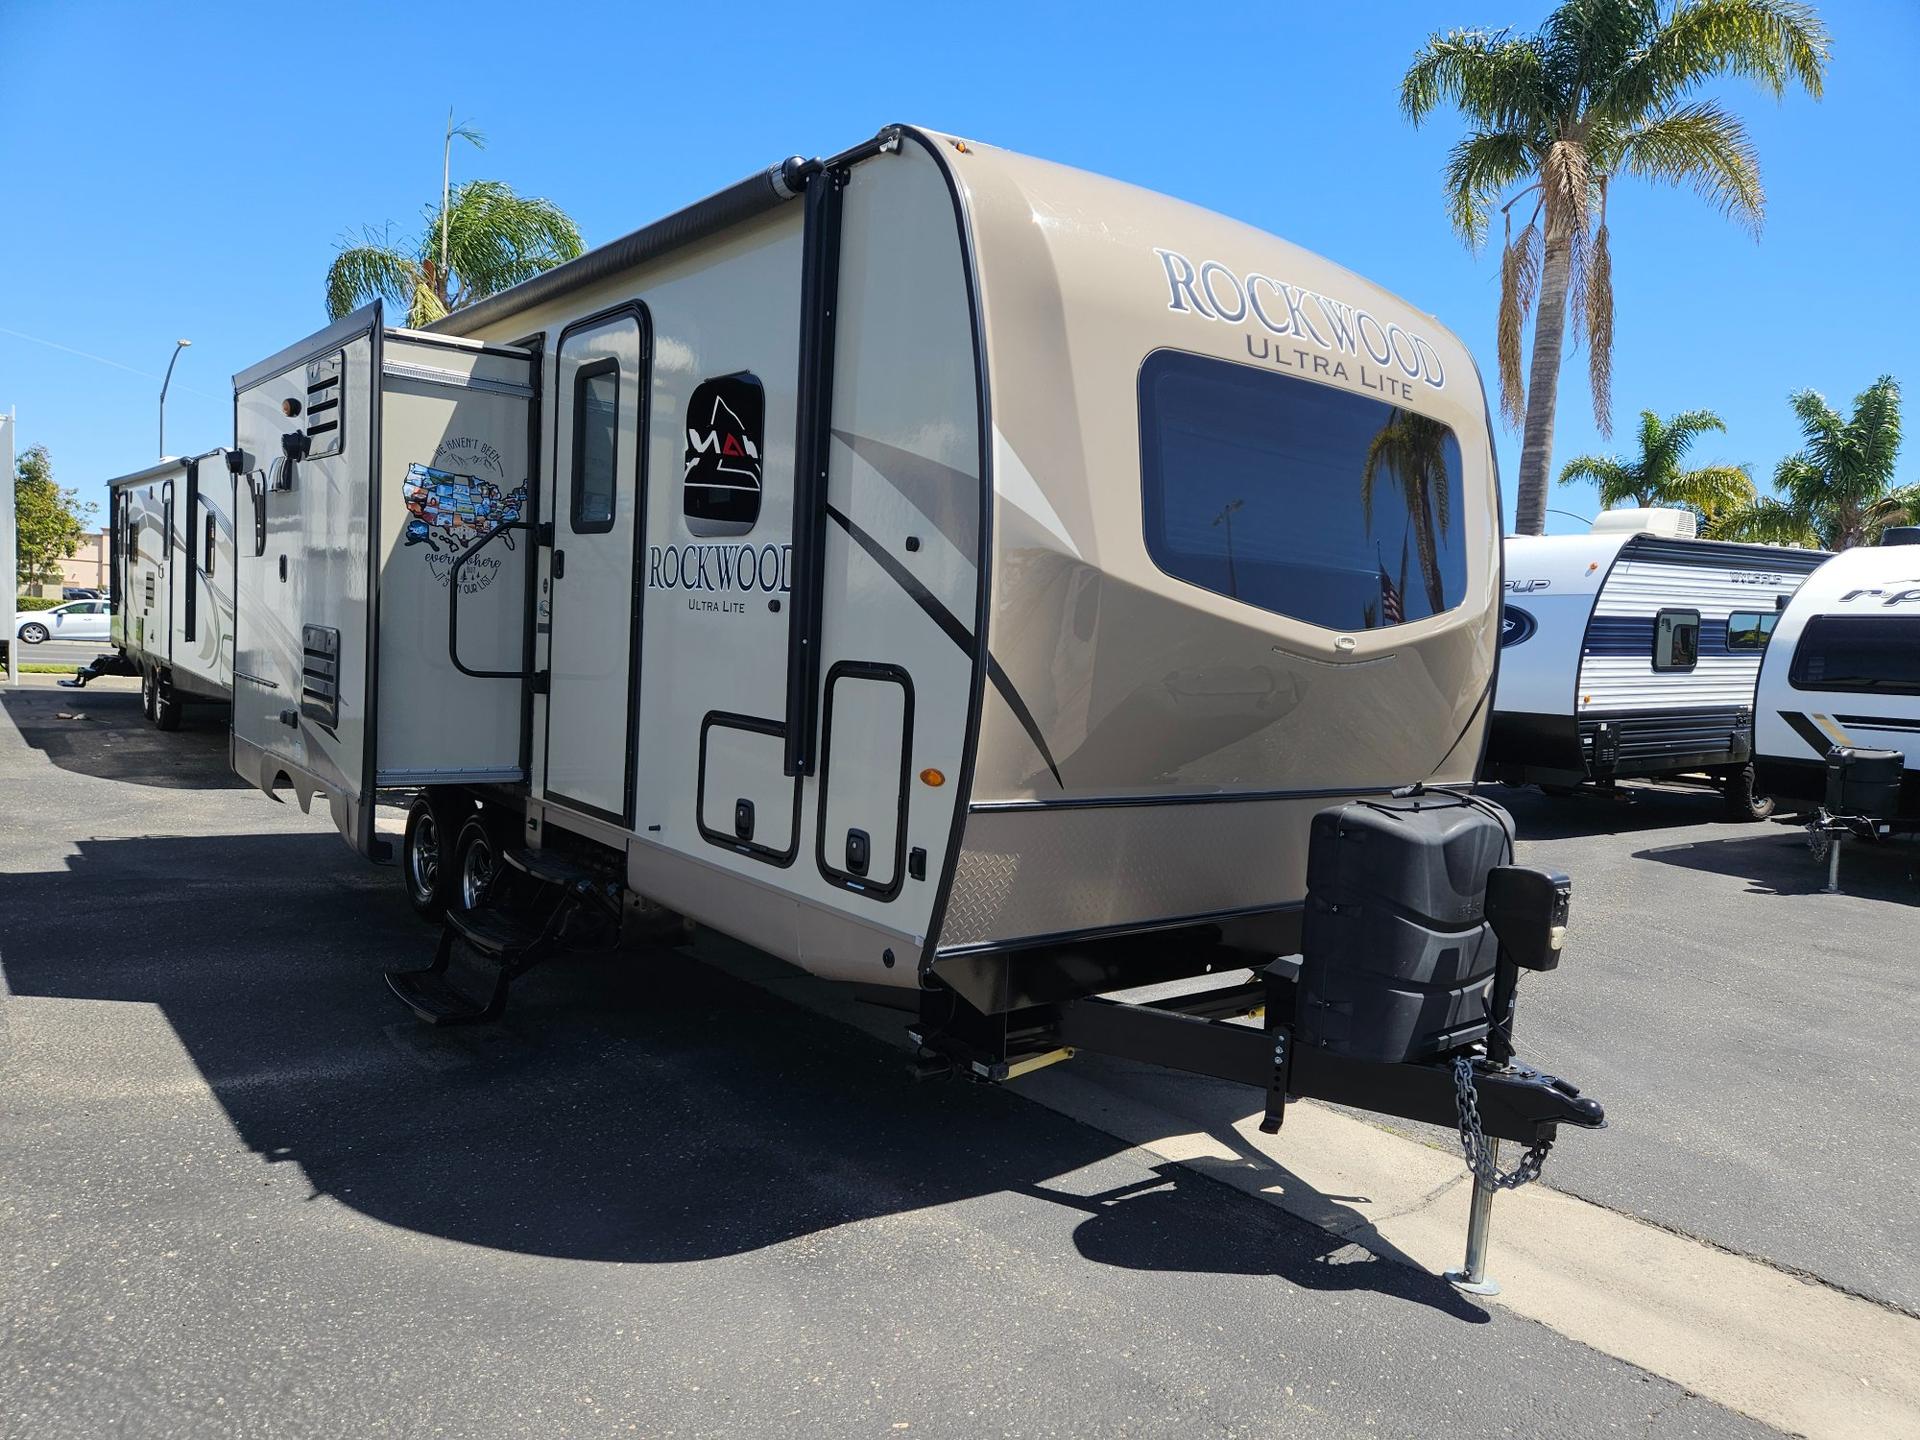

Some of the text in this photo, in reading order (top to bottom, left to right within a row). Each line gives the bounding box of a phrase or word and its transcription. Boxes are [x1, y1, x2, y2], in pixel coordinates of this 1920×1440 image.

[1153, 247, 1446, 390] ROCKWOOD
[1246, 334, 1413, 401] ULTRA LITE
[433, 436, 502, 463] WE HAVEN'T BEEN
[477, 574, 492, 590] LIST
[688, 599, 745, 613] ULTRA LITE
